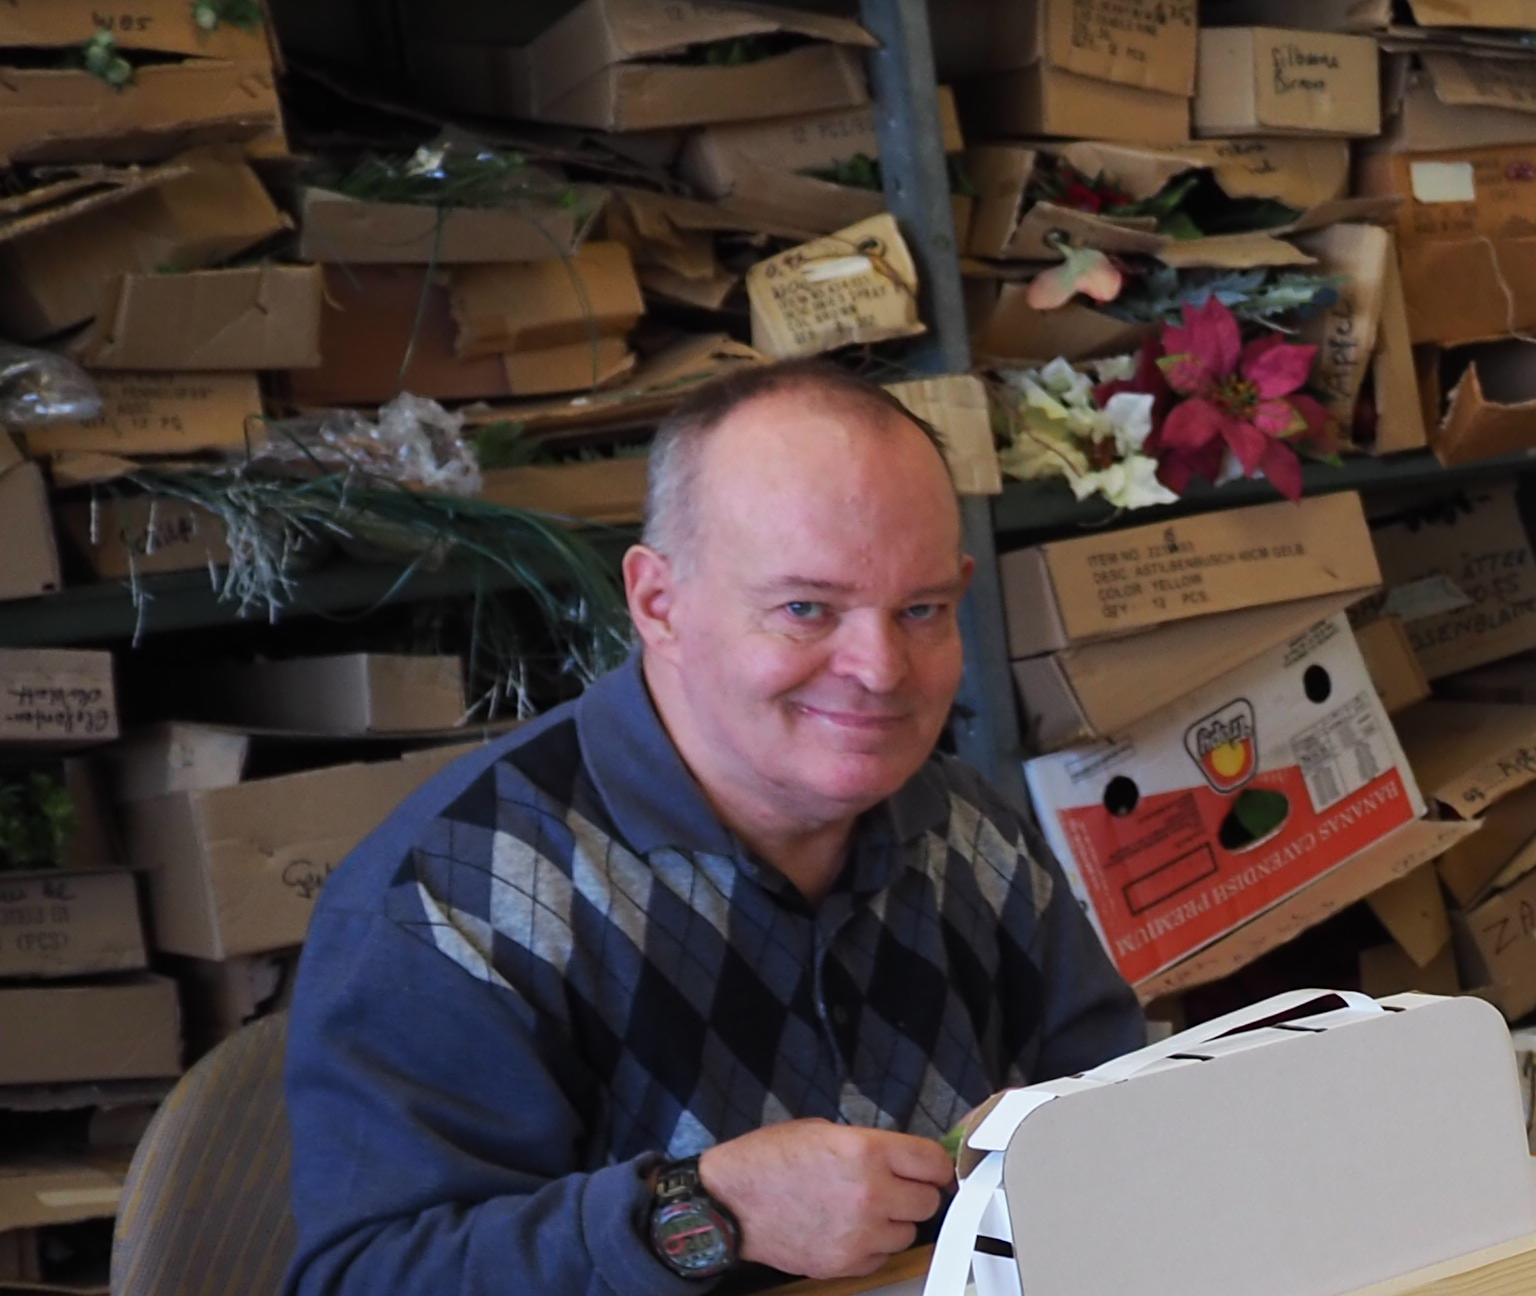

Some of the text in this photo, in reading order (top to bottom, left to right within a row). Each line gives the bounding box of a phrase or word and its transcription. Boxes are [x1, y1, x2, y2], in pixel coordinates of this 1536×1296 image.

[1097, 573, 1204, 601] COLOR YELLOW
[1115, 779, 1401, 957] BANANAS CAVENDISH PREMIUM
